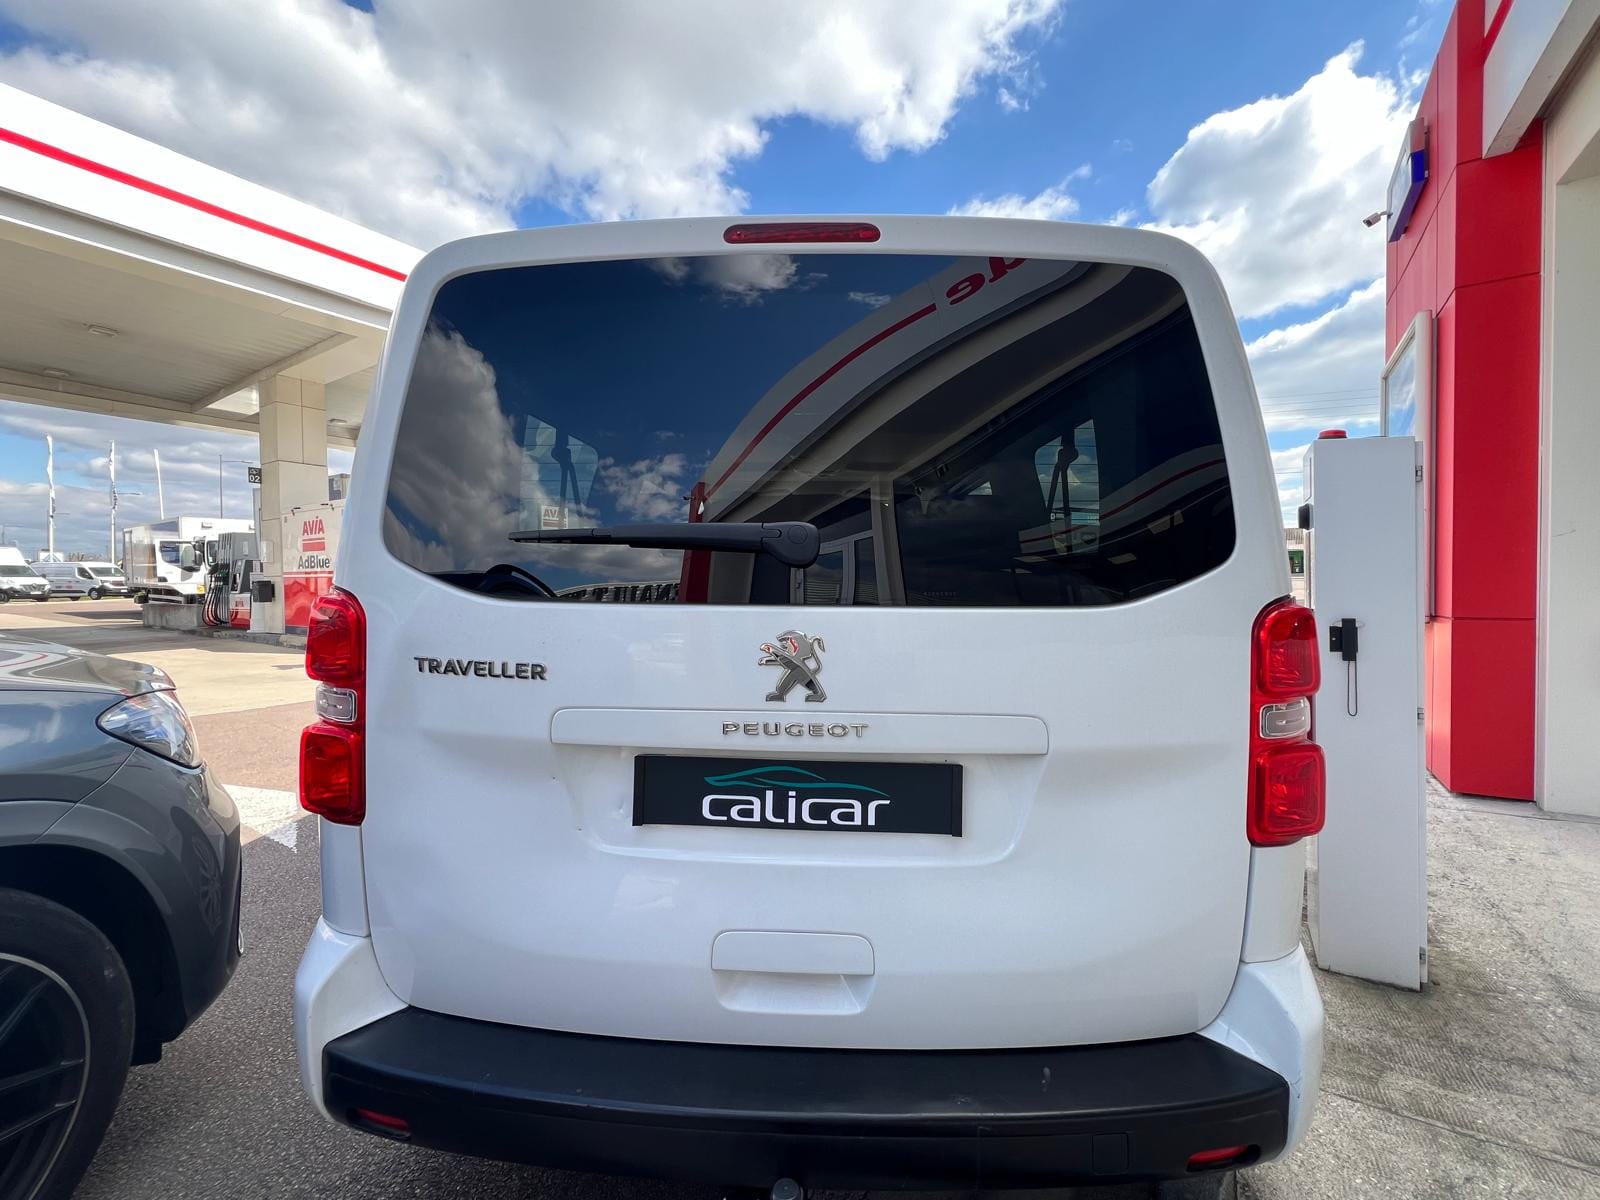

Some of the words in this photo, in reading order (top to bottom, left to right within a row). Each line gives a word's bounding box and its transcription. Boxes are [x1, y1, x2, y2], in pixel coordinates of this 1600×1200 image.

[249, 474, 261, 483] 02
[302, 516, 325, 536] AVIA
[298, 555, 330, 569] AdBlue
[413, 656, 547, 681] TRAVELLER
[722, 721, 868, 737] PEUGEOT
[702, 790, 891, 825] calicar
